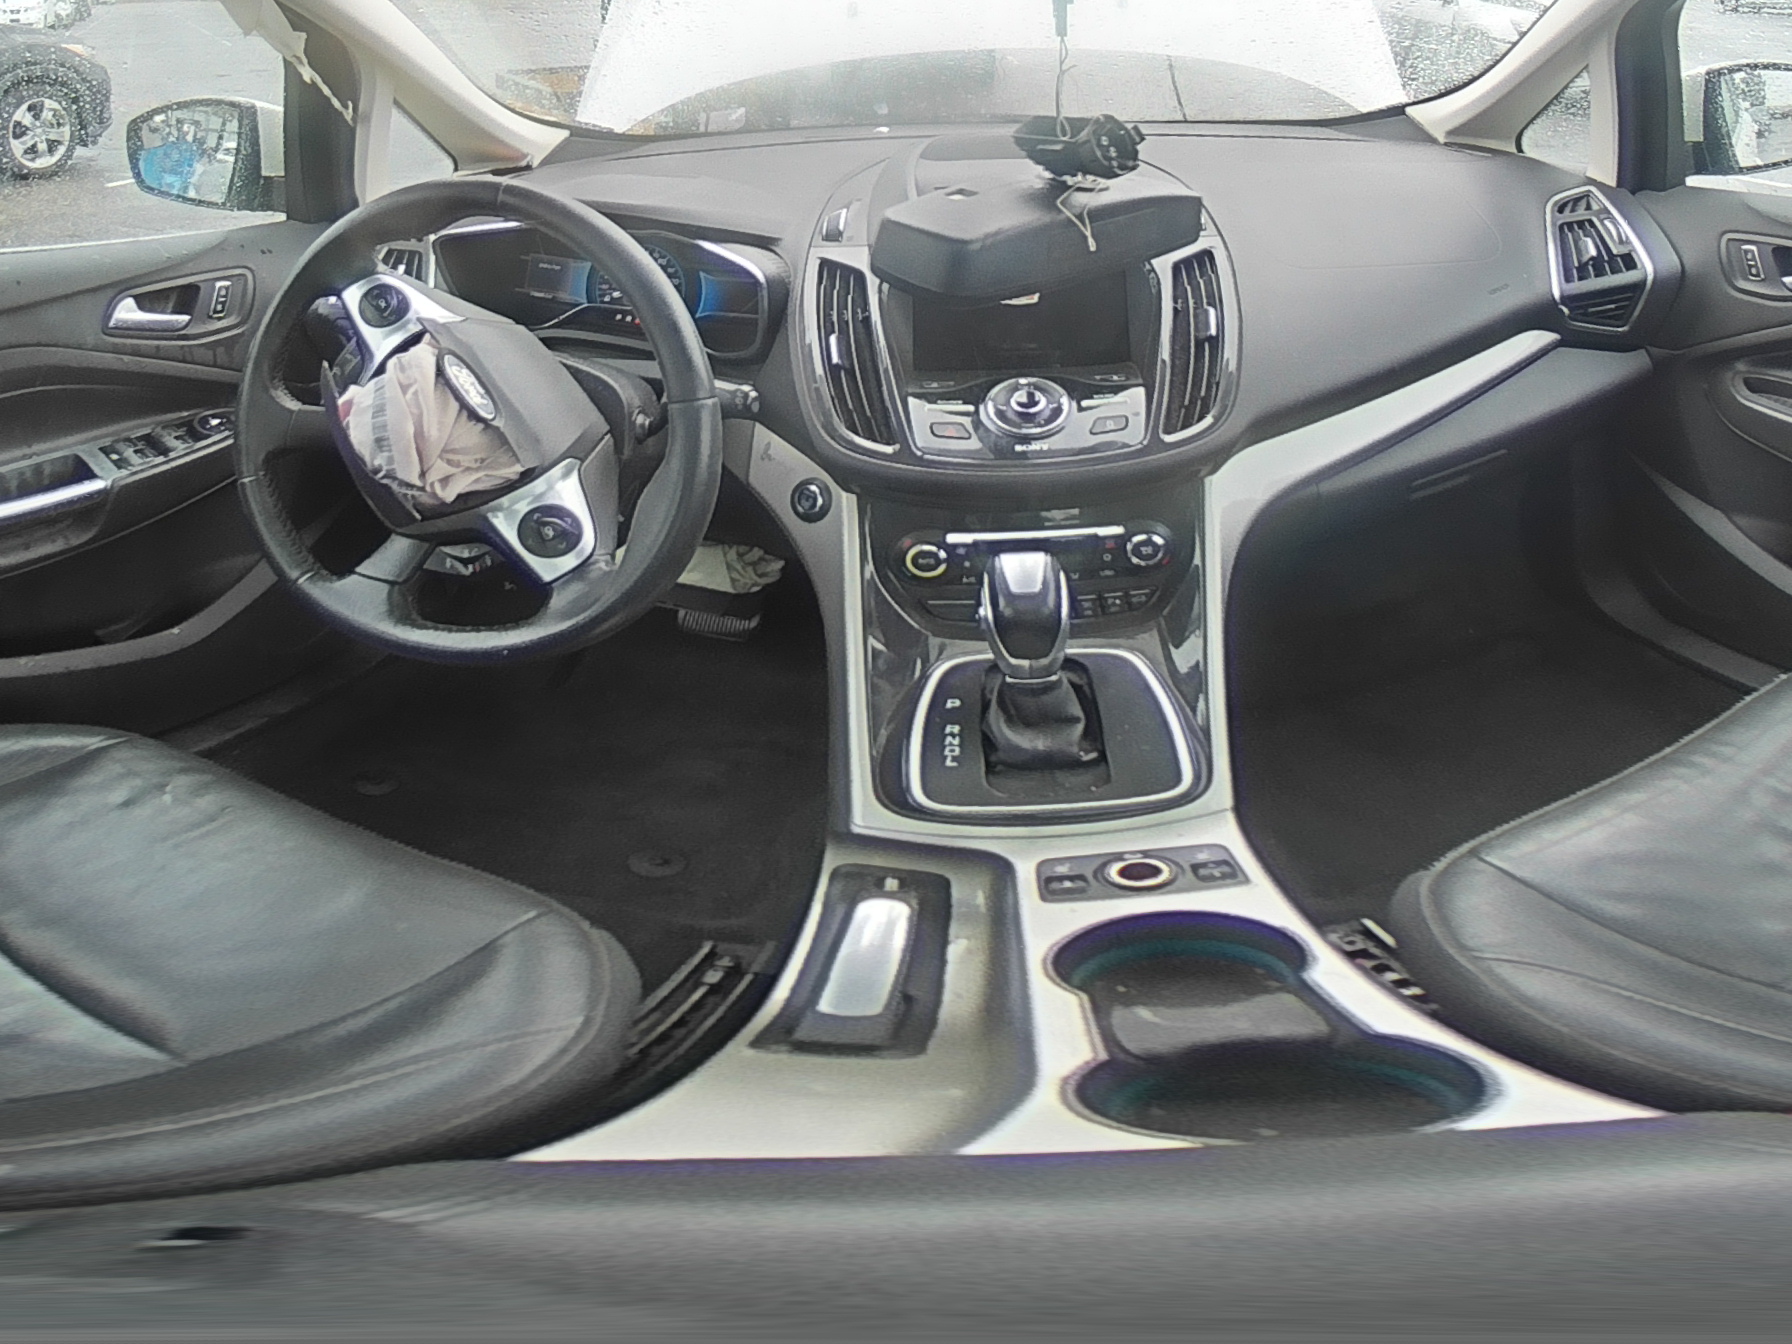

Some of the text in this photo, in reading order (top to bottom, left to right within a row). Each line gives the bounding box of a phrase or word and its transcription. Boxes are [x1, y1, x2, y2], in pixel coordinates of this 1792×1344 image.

[1014, 444, 1049, 452] SONY
[945, 698, 962, 709] P
[944, 724, 961, 734] R
[944, 735, 960, 745] N
[945, 756, 959, 767] L
